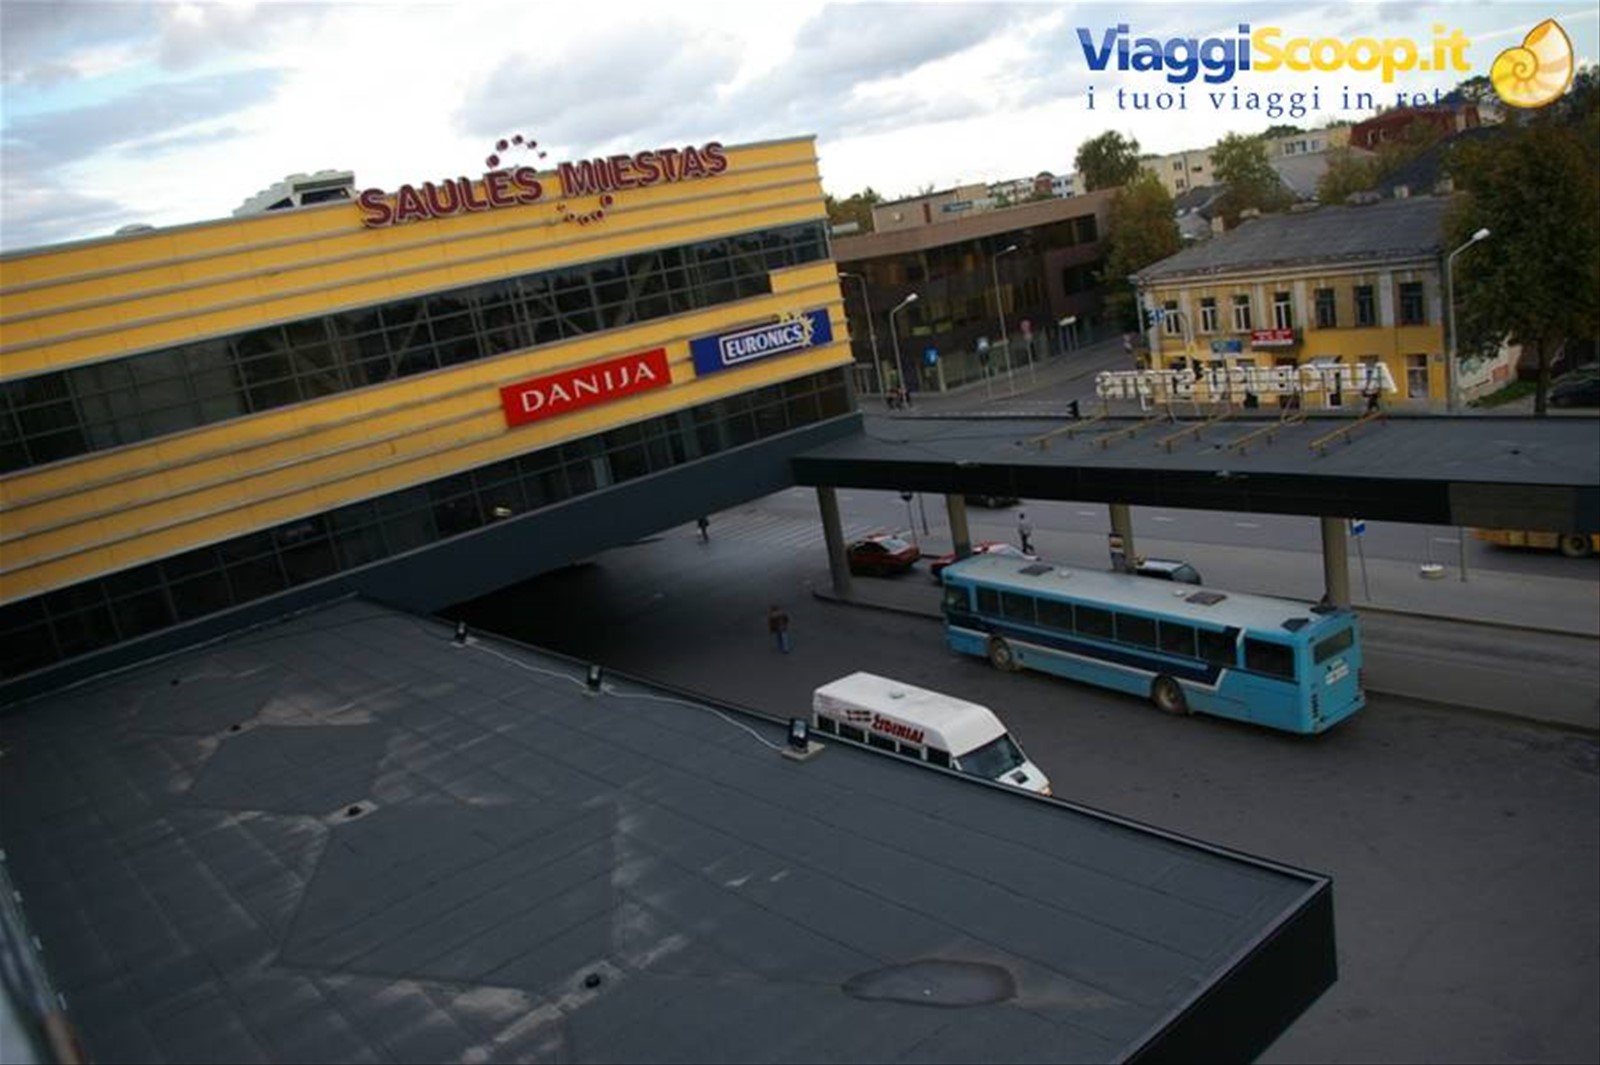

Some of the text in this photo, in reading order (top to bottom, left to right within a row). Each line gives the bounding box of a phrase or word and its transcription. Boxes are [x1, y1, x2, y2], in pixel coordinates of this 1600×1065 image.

[556, 142, 728, 199] MIESTAS
[724, 323, 803, 359] EURONICS
[520, 362, 656, 413] DANIJA
